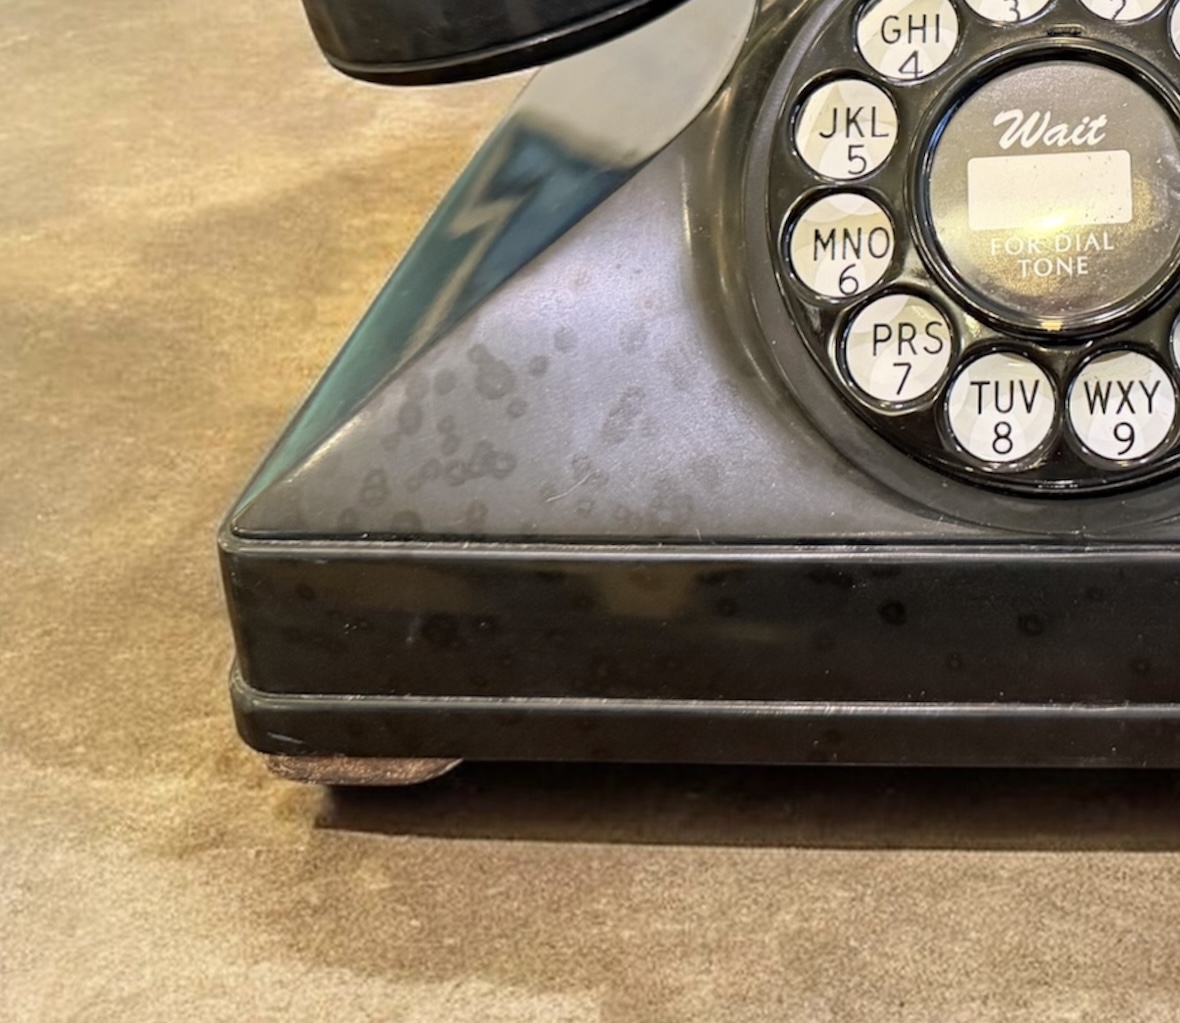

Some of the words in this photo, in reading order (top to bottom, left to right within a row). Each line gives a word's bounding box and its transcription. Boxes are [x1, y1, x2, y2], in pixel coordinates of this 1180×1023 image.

[881, 14, 940, 44] GHI
[898, 50, 923, 78] 4
[819, 106, 889, 139] JKL
[993, 108, 1108, 150] Wait
[847, 144, 867, 175] 5
[813, 227, 890, 261] MNO
[990, 236, 1042, 256] FOR
[1055, 232, 1114, 253] DIAL
[838, 264, 859, 295] 6
[1017, 256, 1088, 277] TONE
[872, 321, 944, 356] PRS
[893, 362, 912, 395] 7
[970, 380, 1040, 415] TUV
[1084, 380, 1161, 415] WXY
[992, 421, 1013, 455] 8
[1113, 422, 1135, 455] 9
